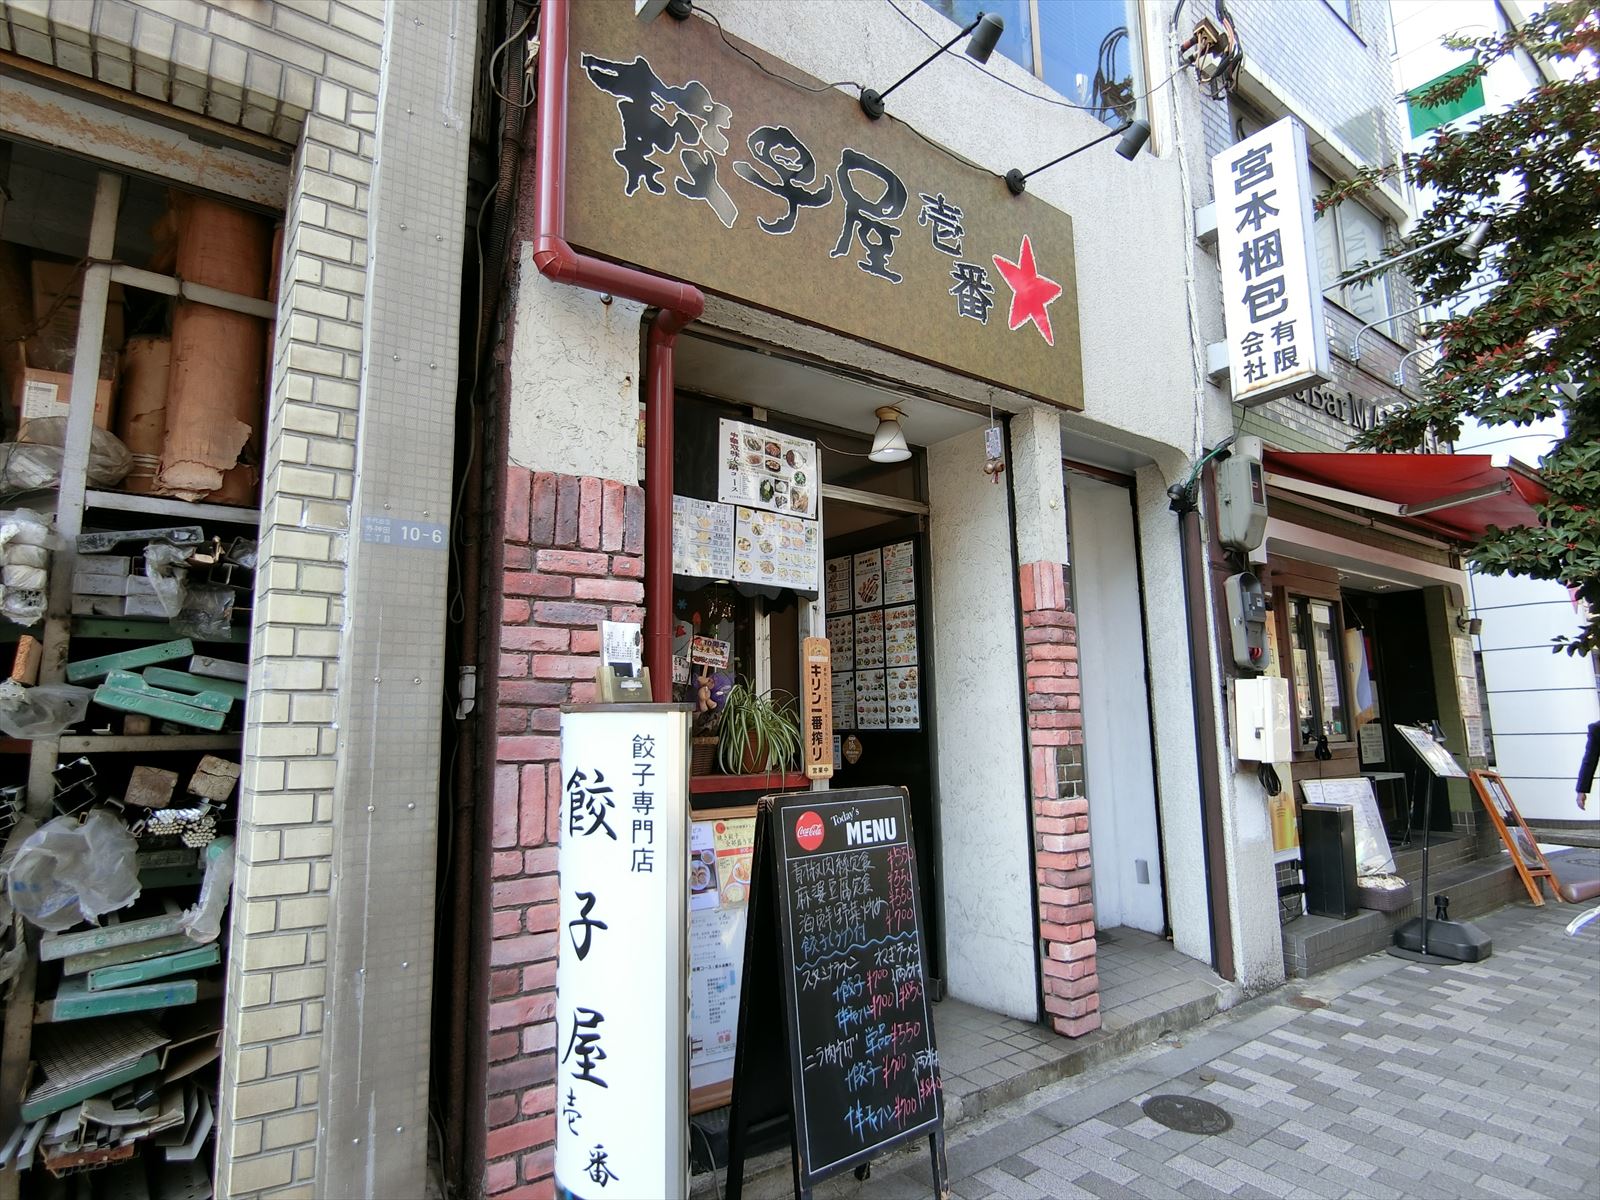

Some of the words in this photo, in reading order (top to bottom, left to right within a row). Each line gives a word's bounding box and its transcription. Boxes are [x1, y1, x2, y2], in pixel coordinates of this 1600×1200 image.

[580, 52, 908, 284] 餃子屋
[917, 192, 995, 326] 壱番
[1230, 141, 1289, 325] 宮本梱包
[1240, 329, 1267, 384] 会社
[1270, 319, 1301, 375] 有限
[401, 526, 442, 543] 10-6
[810, 664, 823, 761] キリン一番搾り
[630, 734, 656, 873] 餃子専門店
[796, 824, 823, 838] Coca-Cola
[830, 807, 860, 827] Today's
[846, 817, 897, 846] MENU
[561, 766, 618, 1089] 餃子屋
